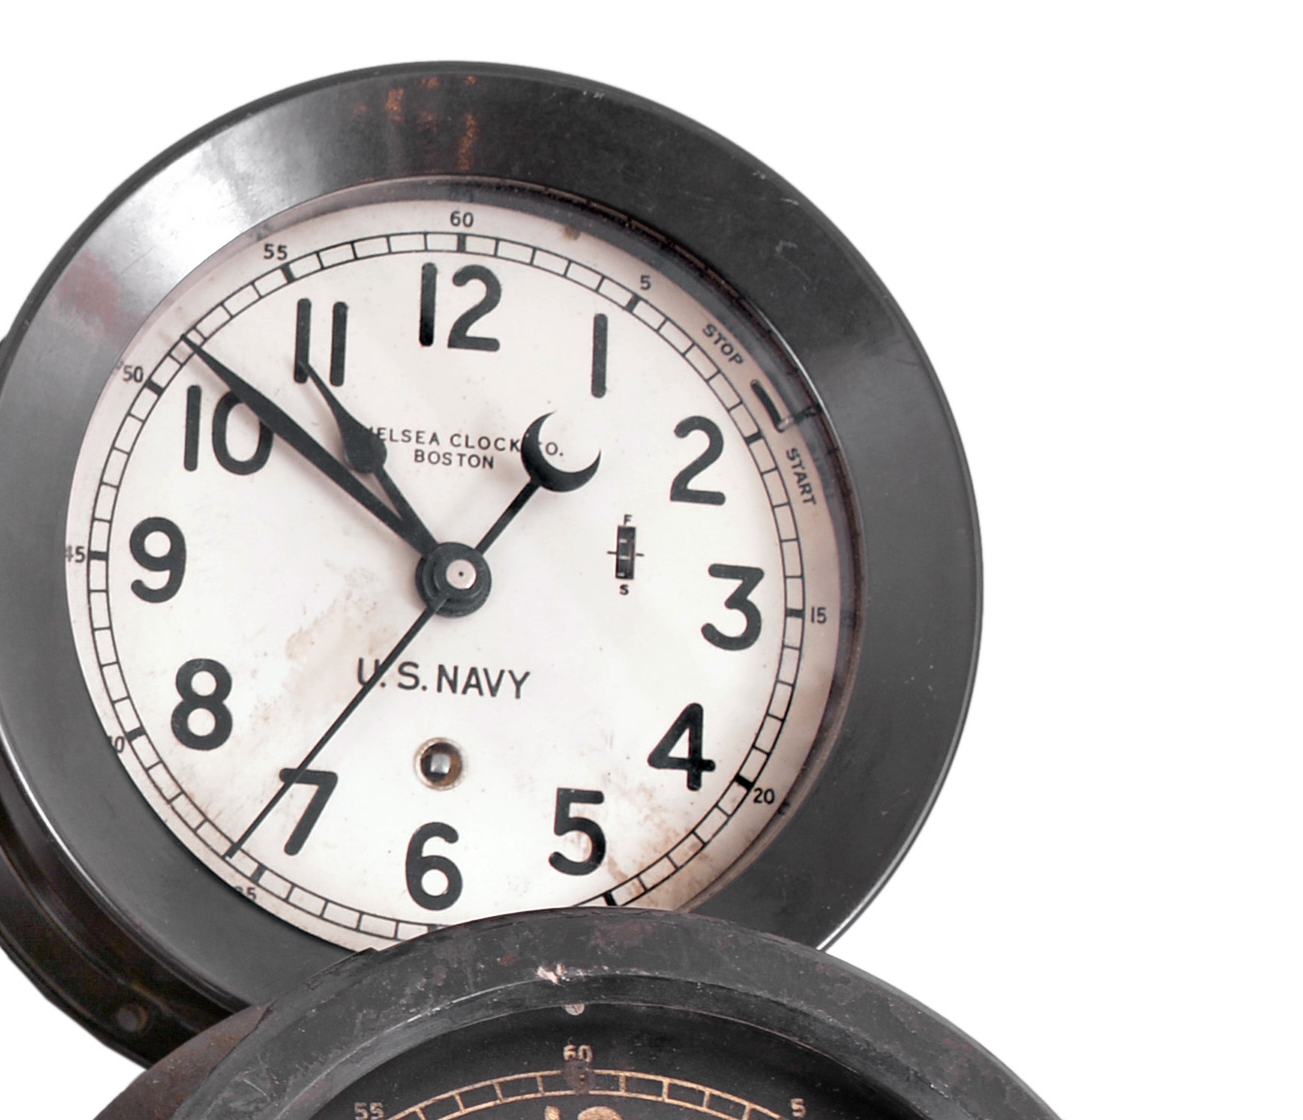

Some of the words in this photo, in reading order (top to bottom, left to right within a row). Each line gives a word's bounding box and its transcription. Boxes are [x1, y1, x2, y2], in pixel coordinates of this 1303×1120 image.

[450, 212, 474, 227] 60
[264, 244, 288, 259] 55
[640, 275, 651, 290] 5
[419, 263, 501, 352] 12
[703, 324, 744, 367] STOP
[123, 366, 143, 383] 50
[184, 385, 274, 475] 10
[366, 426, 440, 445] ELSEA
[450, 433, 519, 452] CLOCK
[414, 450, 493, 469] BOSTON
[786, 448, 816, 506] START
[624, 515, 632, 524] F
[129, 517, 186, 603] 9
[619, 585, 629, 595] S
[701, 564, 764, 651] 3
[811, 608, 826, 623] 15
[437, 664, 530, 699] NAVY
[753, 789, 774, 804] 20
[405, 822, 463, 910] 6
[563, 1045, 593, 1064] 60
[791, 1099, 806, 1118] 5
